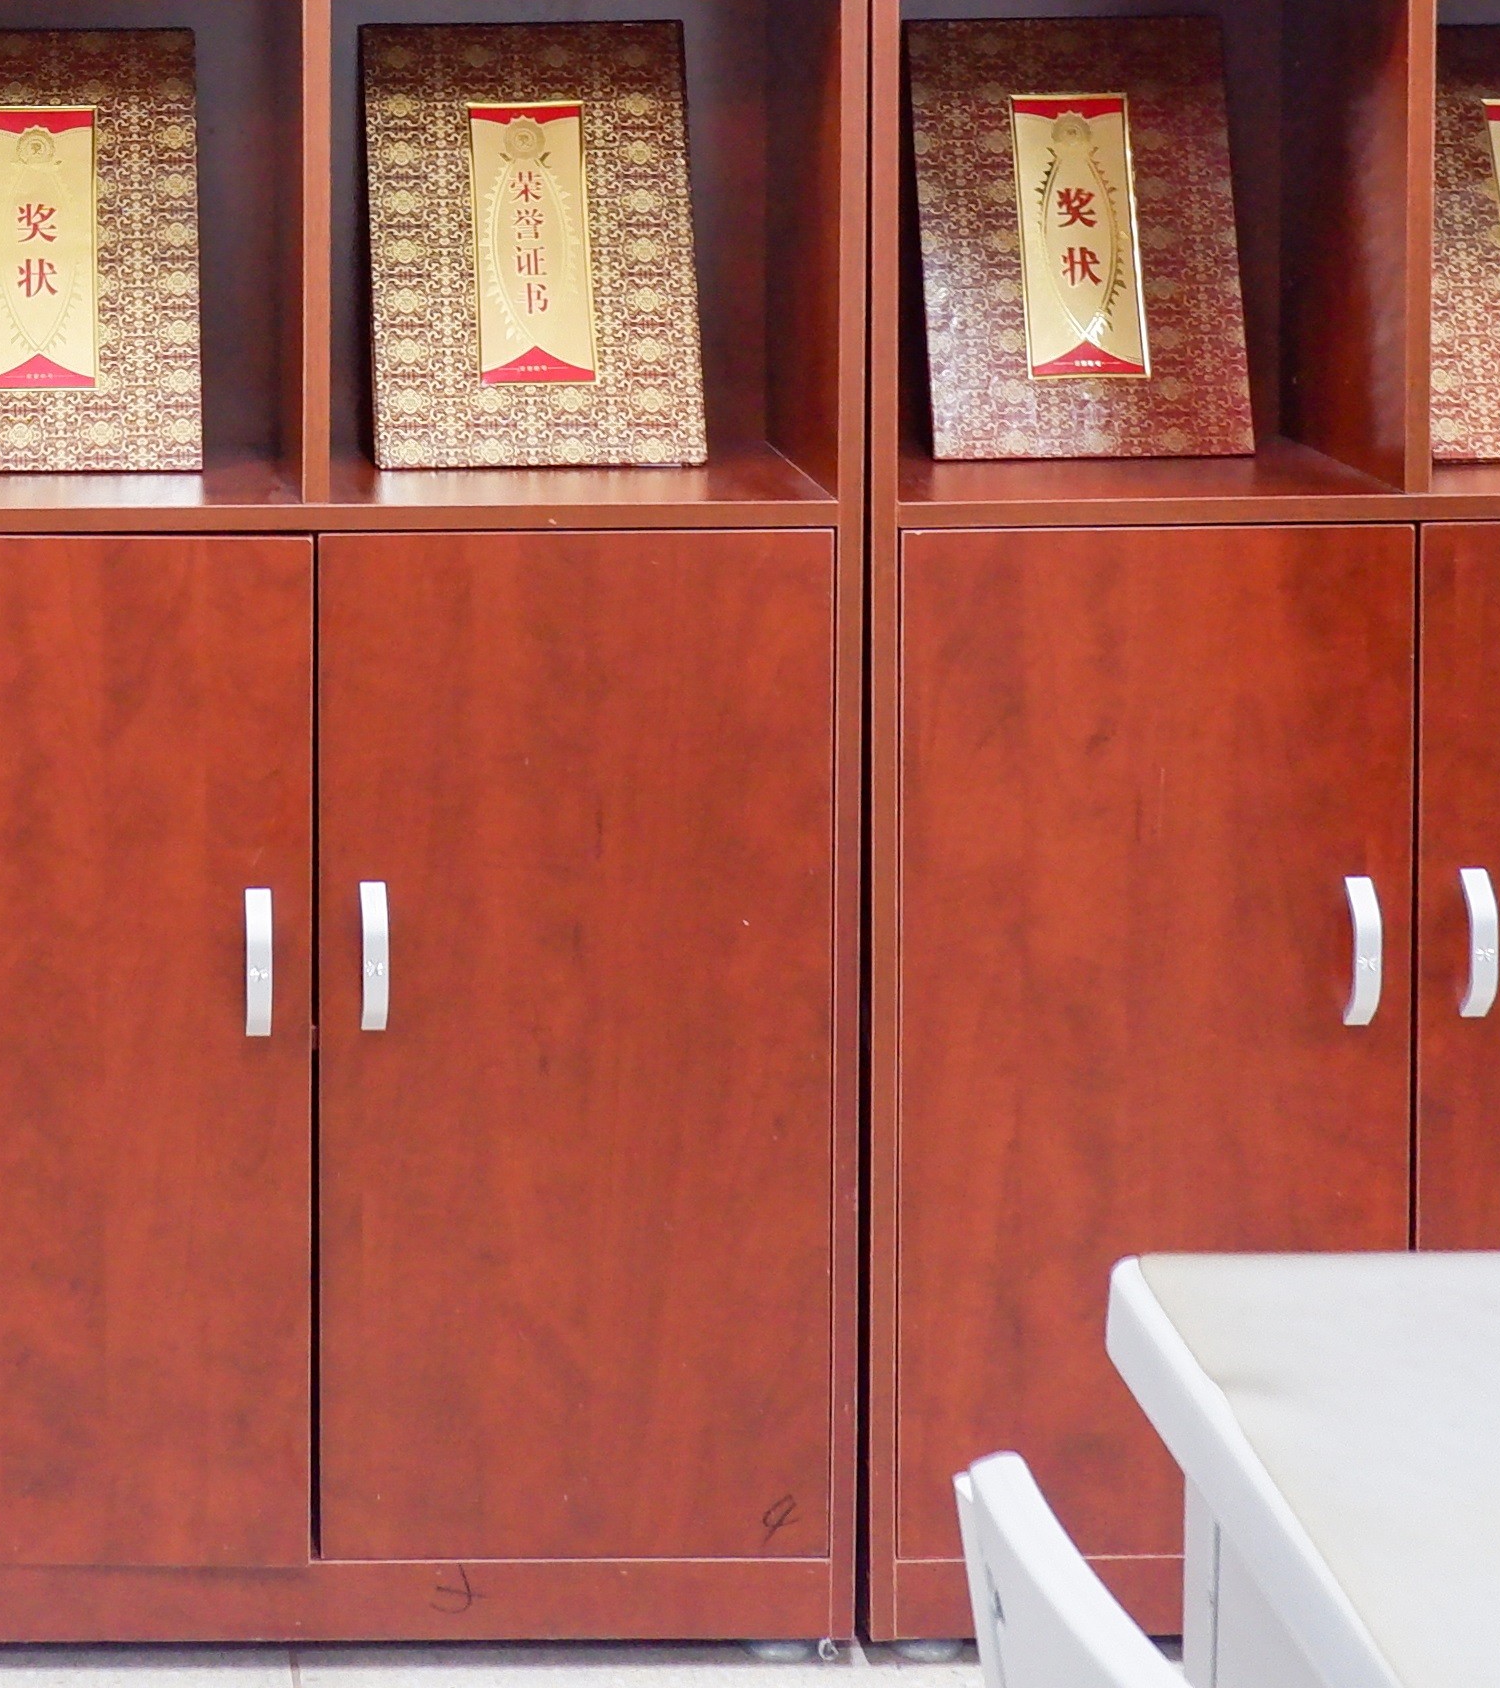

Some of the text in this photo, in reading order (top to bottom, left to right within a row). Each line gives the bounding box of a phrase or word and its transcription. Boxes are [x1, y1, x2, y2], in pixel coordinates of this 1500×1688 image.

[16, 200, 58, 300] 奖状
[507, 168, 551, 316] 荣誉证书
[1055, 187, 1103, 288] 奖状
